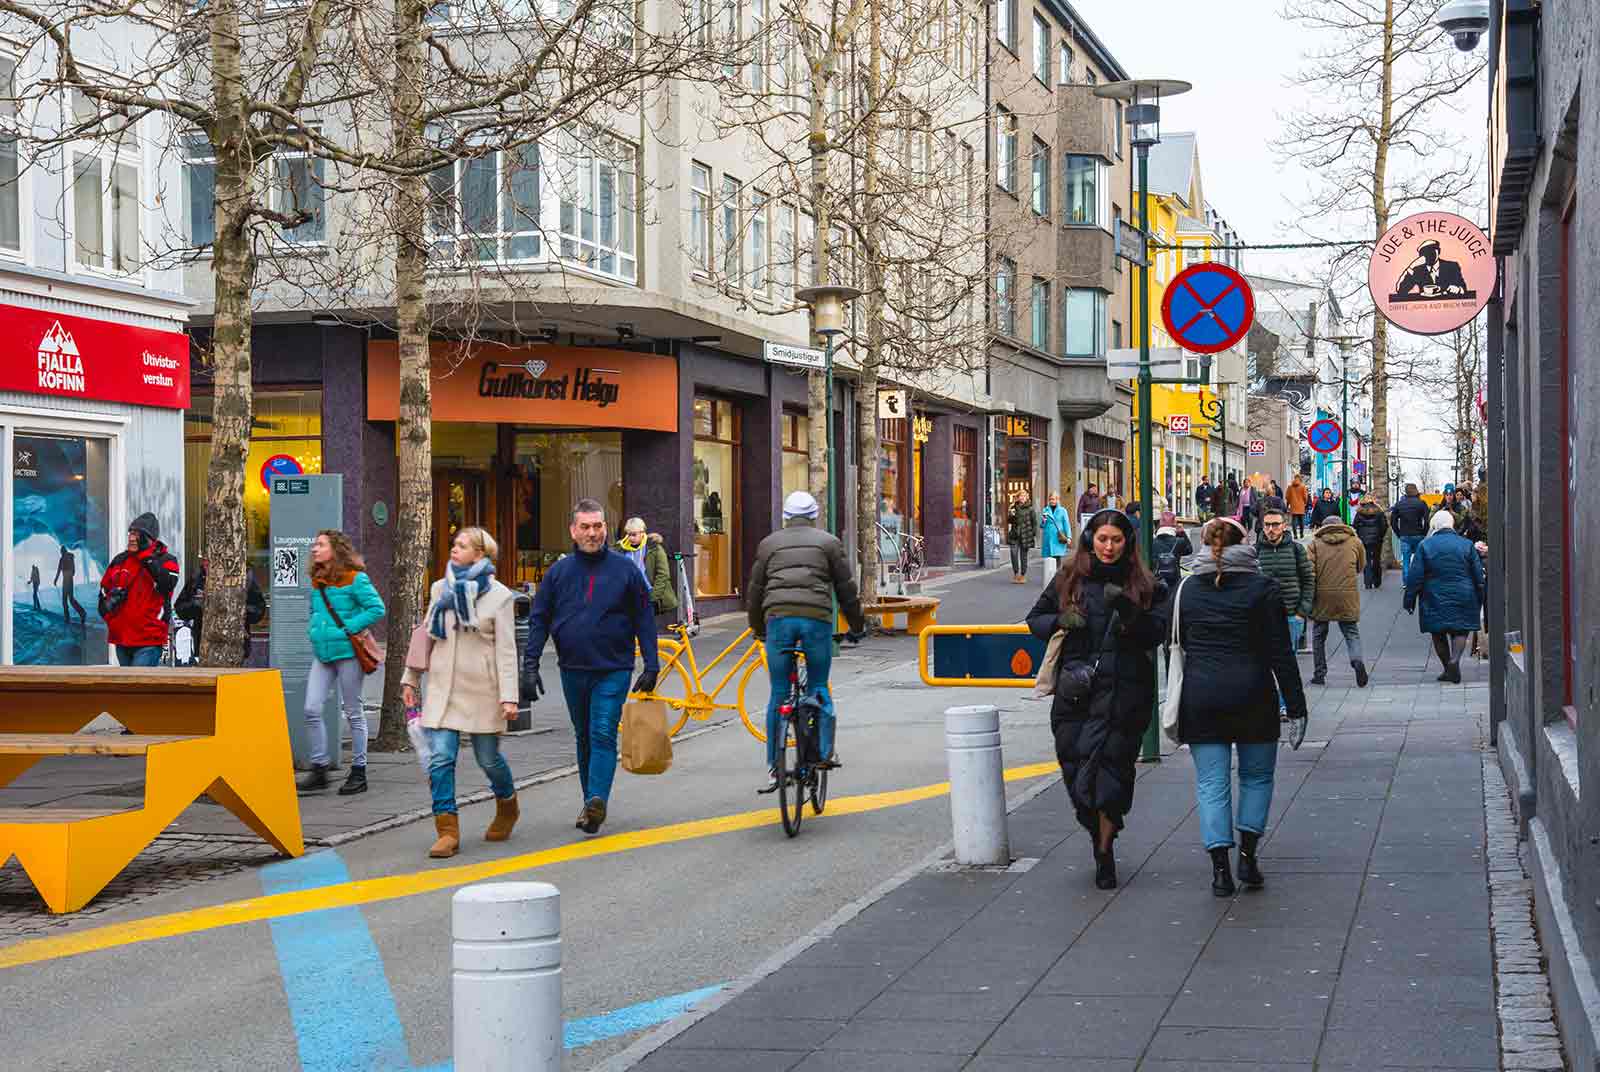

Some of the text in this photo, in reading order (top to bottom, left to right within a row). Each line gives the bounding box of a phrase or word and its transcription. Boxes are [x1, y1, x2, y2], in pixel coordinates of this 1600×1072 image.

[1379, 219, 1487, 263] JOE & THE JUICE
[38, 352, 84, 375] FJALLA
[38, 371, 85, 392] KOFINN
[143, 373, 173, 387] verslun
[572, 367, 619, 408] Helgu
